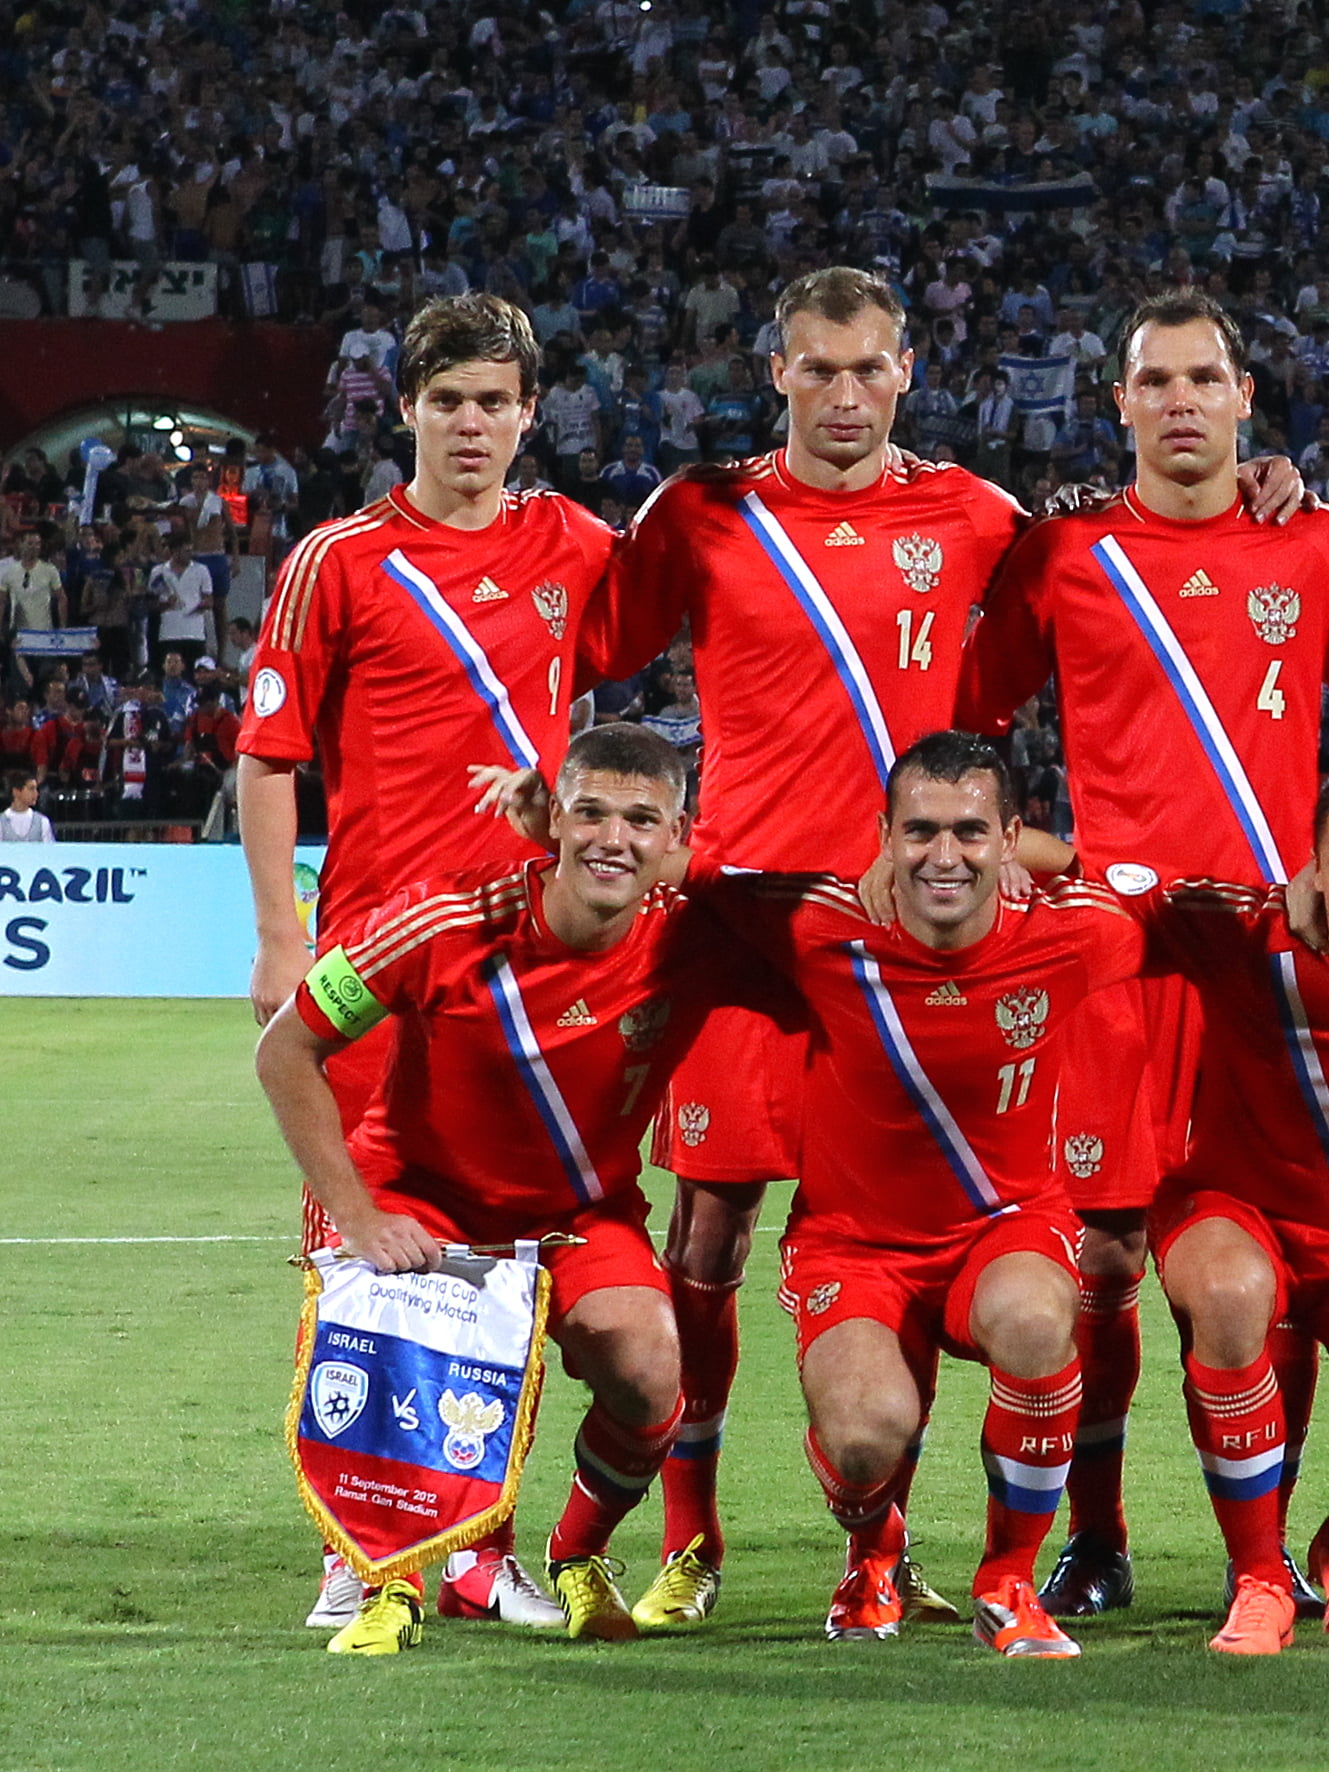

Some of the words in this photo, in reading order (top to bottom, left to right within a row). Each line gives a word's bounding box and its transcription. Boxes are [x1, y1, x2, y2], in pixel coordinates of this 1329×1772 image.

[825, 536, 865, 547] adidas
[472, 590, 509, 603] adidas
[1179, 586, 1219, 598] adidas
[896, 609, 935, 671] 14
[549, 656, 561, 716] 9
[1257, 660, 1286, 719] 4
[3, 916, 51, 971] S
[320, 974, 359, 1025] RESPECT
[925, 996, 968, 1006] adidas
[556, 1015, 598, 1028] adidas
[620, 1062, 651, 1116] 7
[996, 1057, 1036, 1115] 11
[370, 1282, 432, 1314] Qualifying
[436, 1301, 478, 1324] Match
[410, 1272, 448, 1294] World
[452, 1283, 478, 1304] Cup
[327, 1331, 377, 1355] ISRAEL
[325, 1369, 359, 1387] ISRAEL
[449, 1362, 507, 1387] RUSSIA
[1019, 1431, 1073, 1456] RFU
[1222, 1420, 1276, 1450] RFU
[334, 1485, 368, 1502] Ramat
[371, 1493, 393, 1507] Gan
[396, 1499, 439, 1518] Stadium
[339, 1472, 349, 1485] 11
[350, 1475, 409, 1498] September
[413, 1489, 438, 1504] 2012
